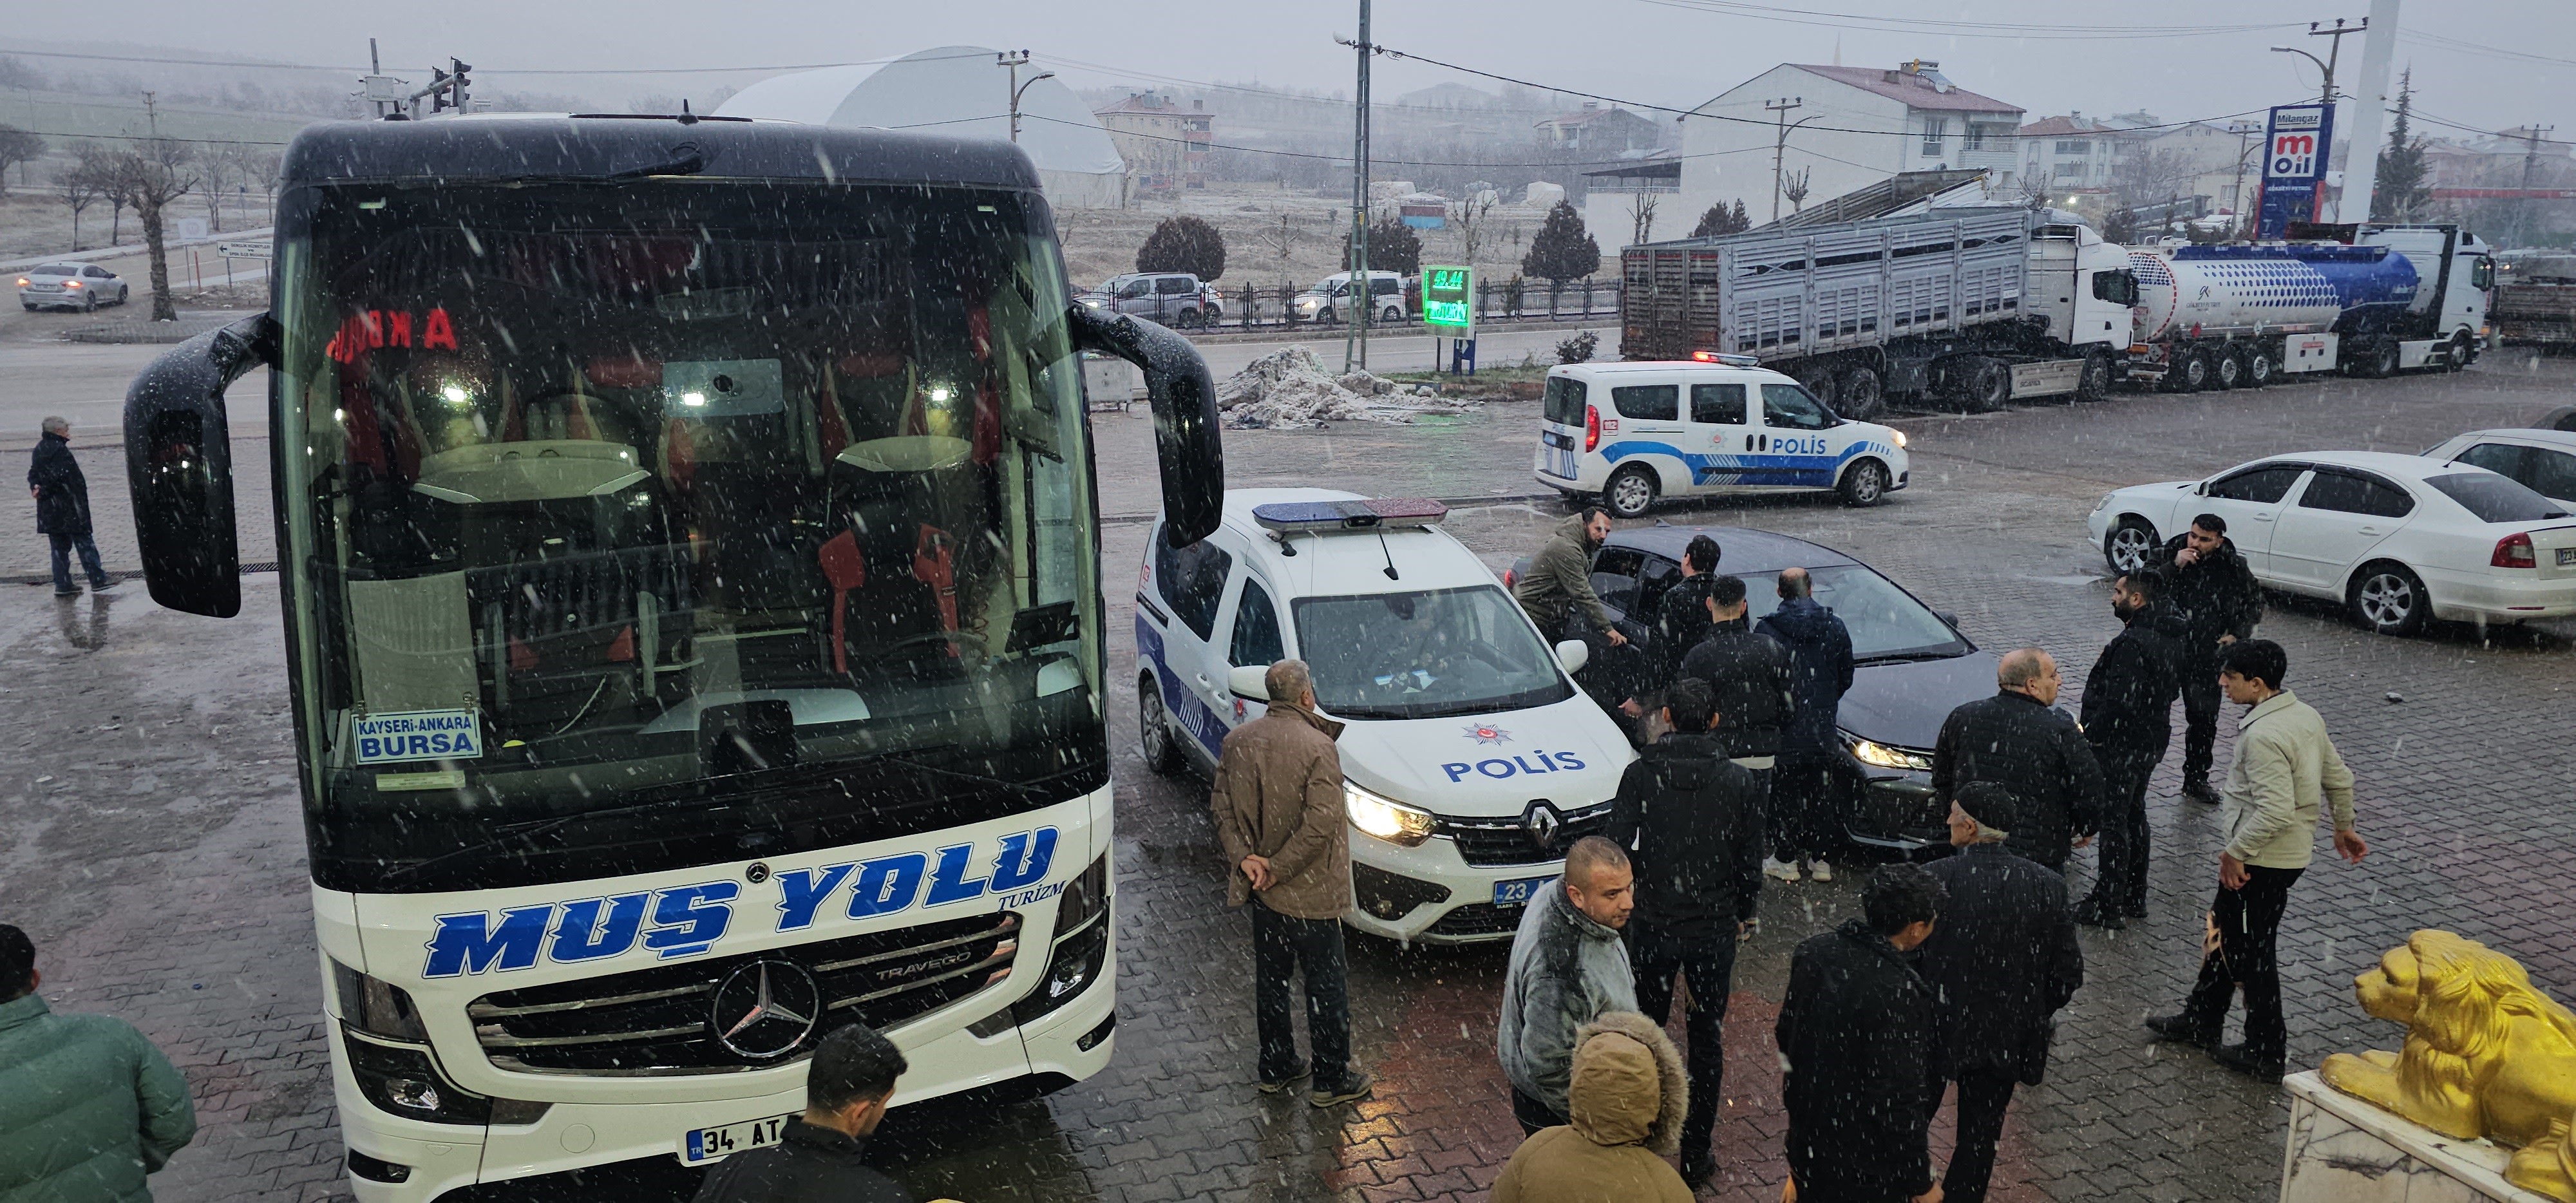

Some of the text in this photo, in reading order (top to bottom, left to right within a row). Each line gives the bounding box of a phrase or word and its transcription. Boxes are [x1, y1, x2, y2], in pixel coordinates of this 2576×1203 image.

[2277, 113, 2319, 124] Milangaz
[2277, 135, 2313, 155] m
[1433, 270, 1463, 289] 49.44
[1772, 435, 1826, 455] POLİS
[361, 732, 475, 757] BURSA
[1441, 750, 1586, 783] POLİS
[422, 826, 1061, 979] MUŞ YOLU
[998, 880, 1067, 911] TURİZM
[1504, 883, 1527, 900] 23
[876, 951, 971, 981] TRAVEGO
[691, 1119, 780, 1155] TR 34 AT
